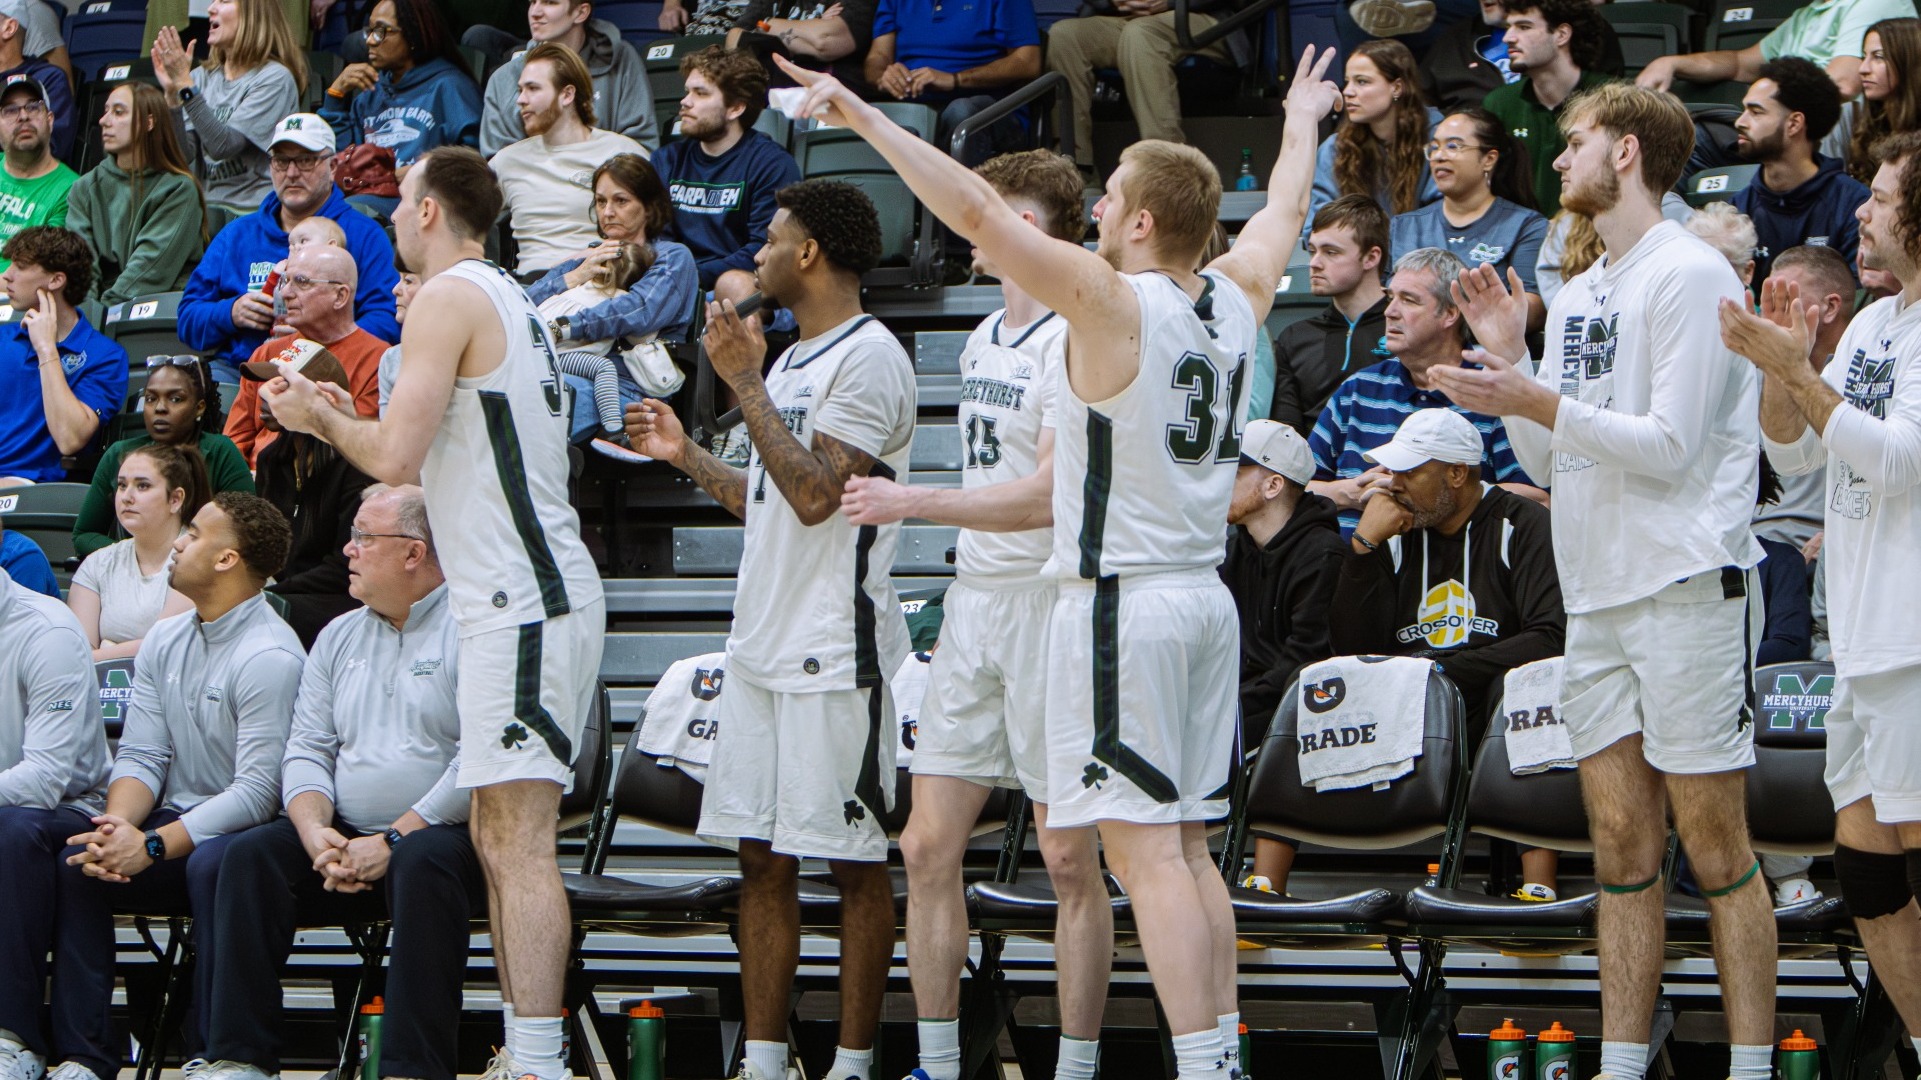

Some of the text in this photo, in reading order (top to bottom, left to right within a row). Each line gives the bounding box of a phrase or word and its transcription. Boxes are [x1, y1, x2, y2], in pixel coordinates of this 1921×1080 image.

[654, 47, 667, 57] 20
[112, 70, 123, 79] 16
[284, 117, 304, 131] M
[1705, 179, 1721, 190] 25
[0, 192, 36, 220] FALO
[138, 304, 150, 316] 19
[961, 377, 1026, 412] ERCYHURST
[1165, 350, 1247, 465] 31
[966, 413, 1002, 469] 15
[903, 603, 919, 614] 23
[1397, 615, 1498, 643] CROSSOVER
[48, 699, 73, 712] NEC
[1297, 722, 1378, 755] RADE
